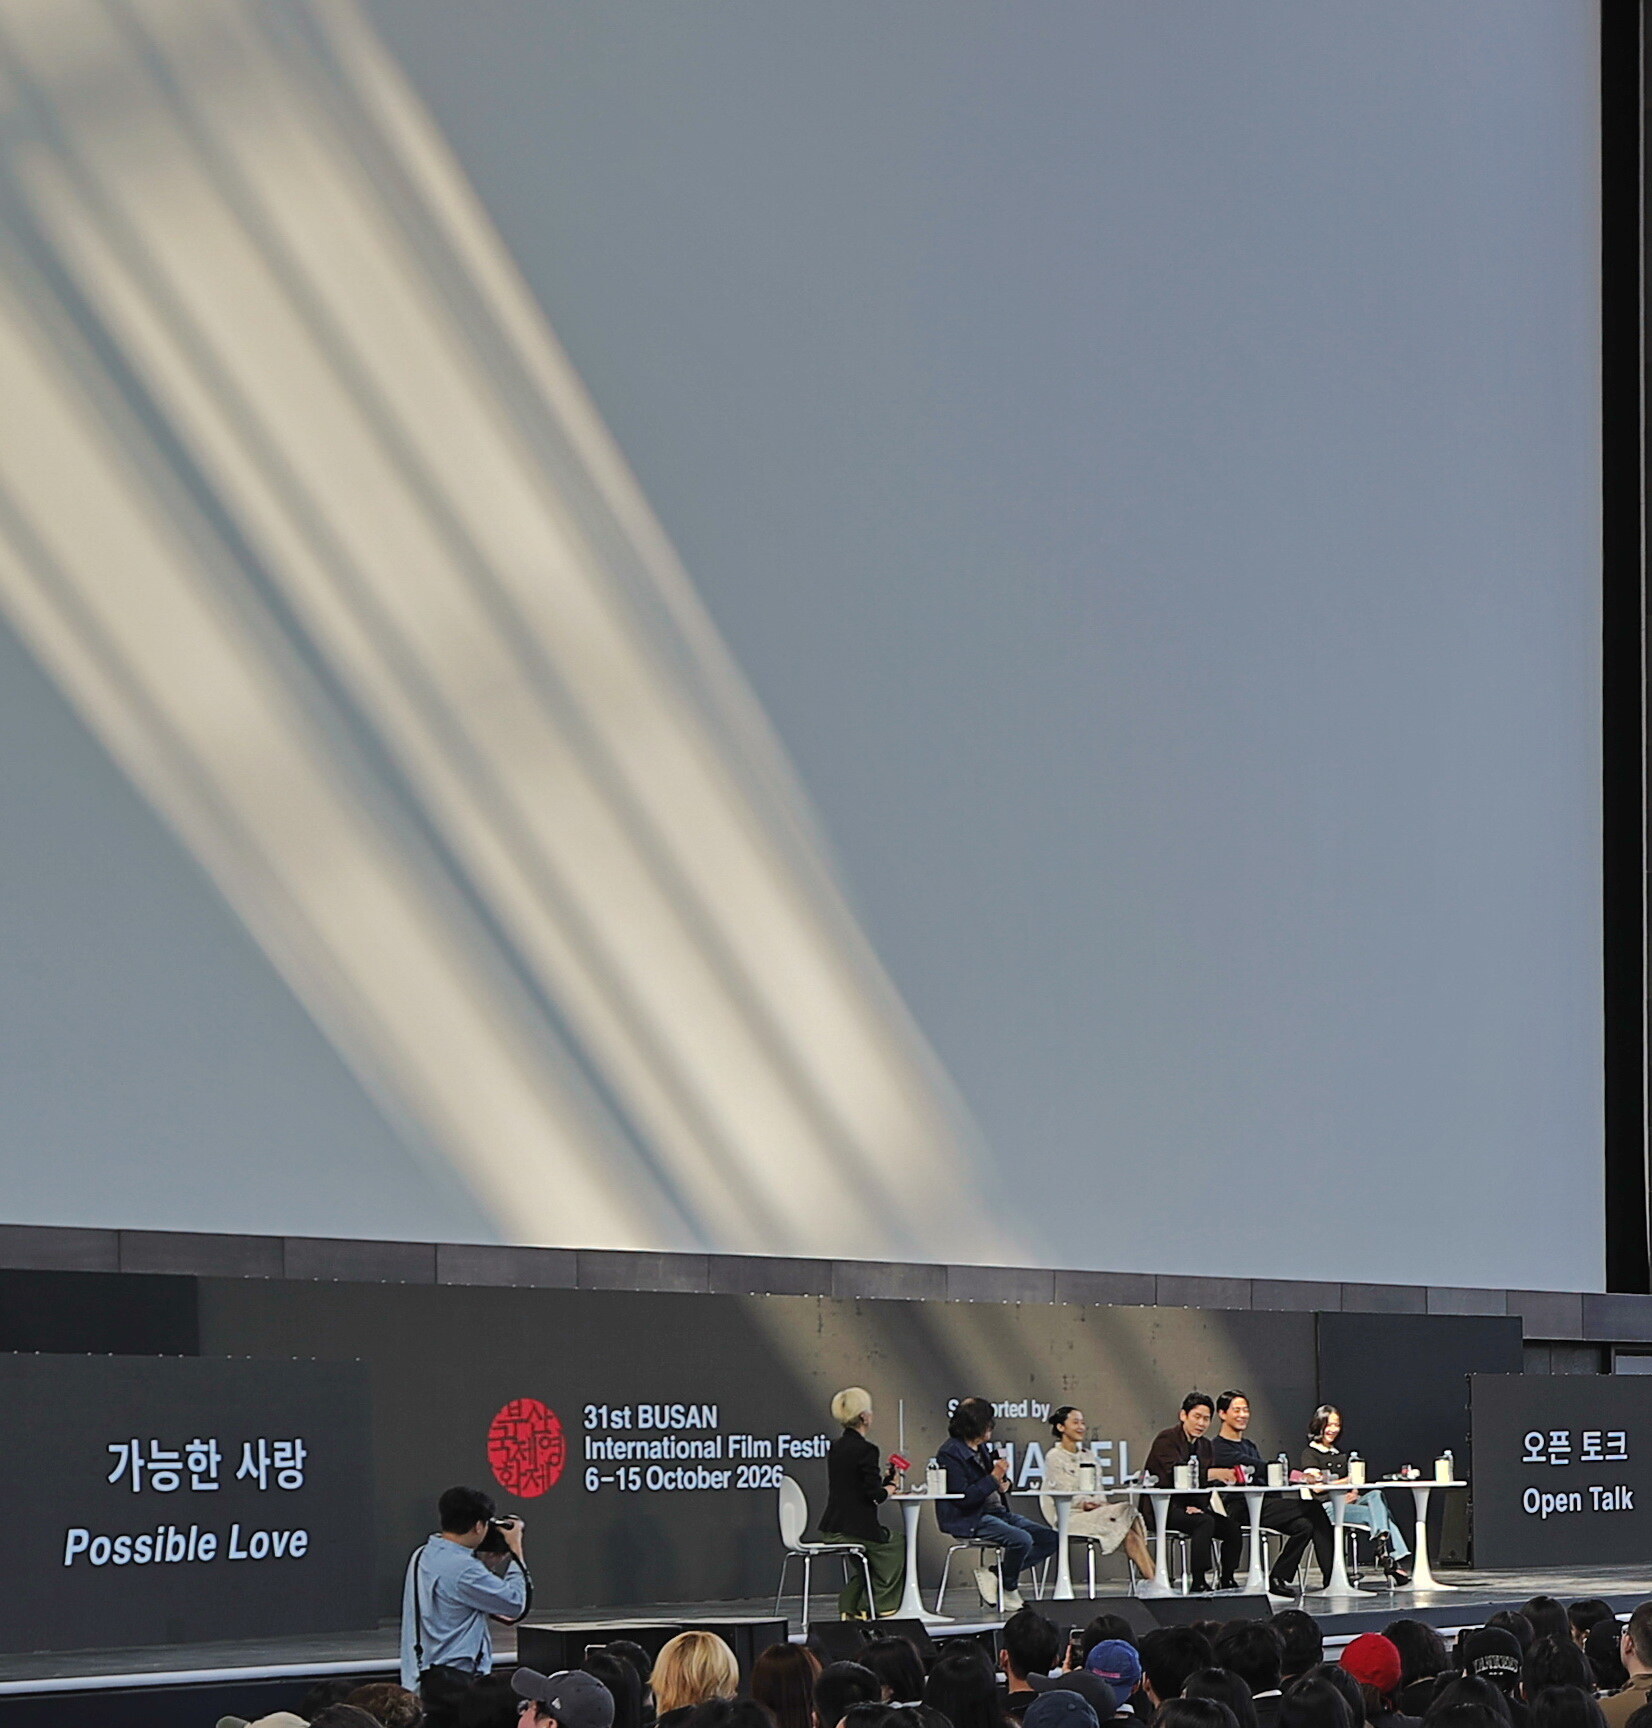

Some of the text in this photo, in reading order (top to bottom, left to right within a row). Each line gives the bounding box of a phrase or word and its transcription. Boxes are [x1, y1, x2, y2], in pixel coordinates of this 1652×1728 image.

[583, 1403, 718, 1430] 31st BUSAN
[1032, 1399, 1051, 1423] by
[584, 1434, 831, 1460] International Film Festiv
[1522, 1430, 1629, 1465] 오픈 토크
[107, 1437, 307, 1493] 가능한 사랑
[645, 1465, 732, 1490] October
[736, 1464, 784, 1489] 2026
[1523, 1485, 1634, 1520] Open Talk
[64, 1523, 309, 1566] Possible Love
